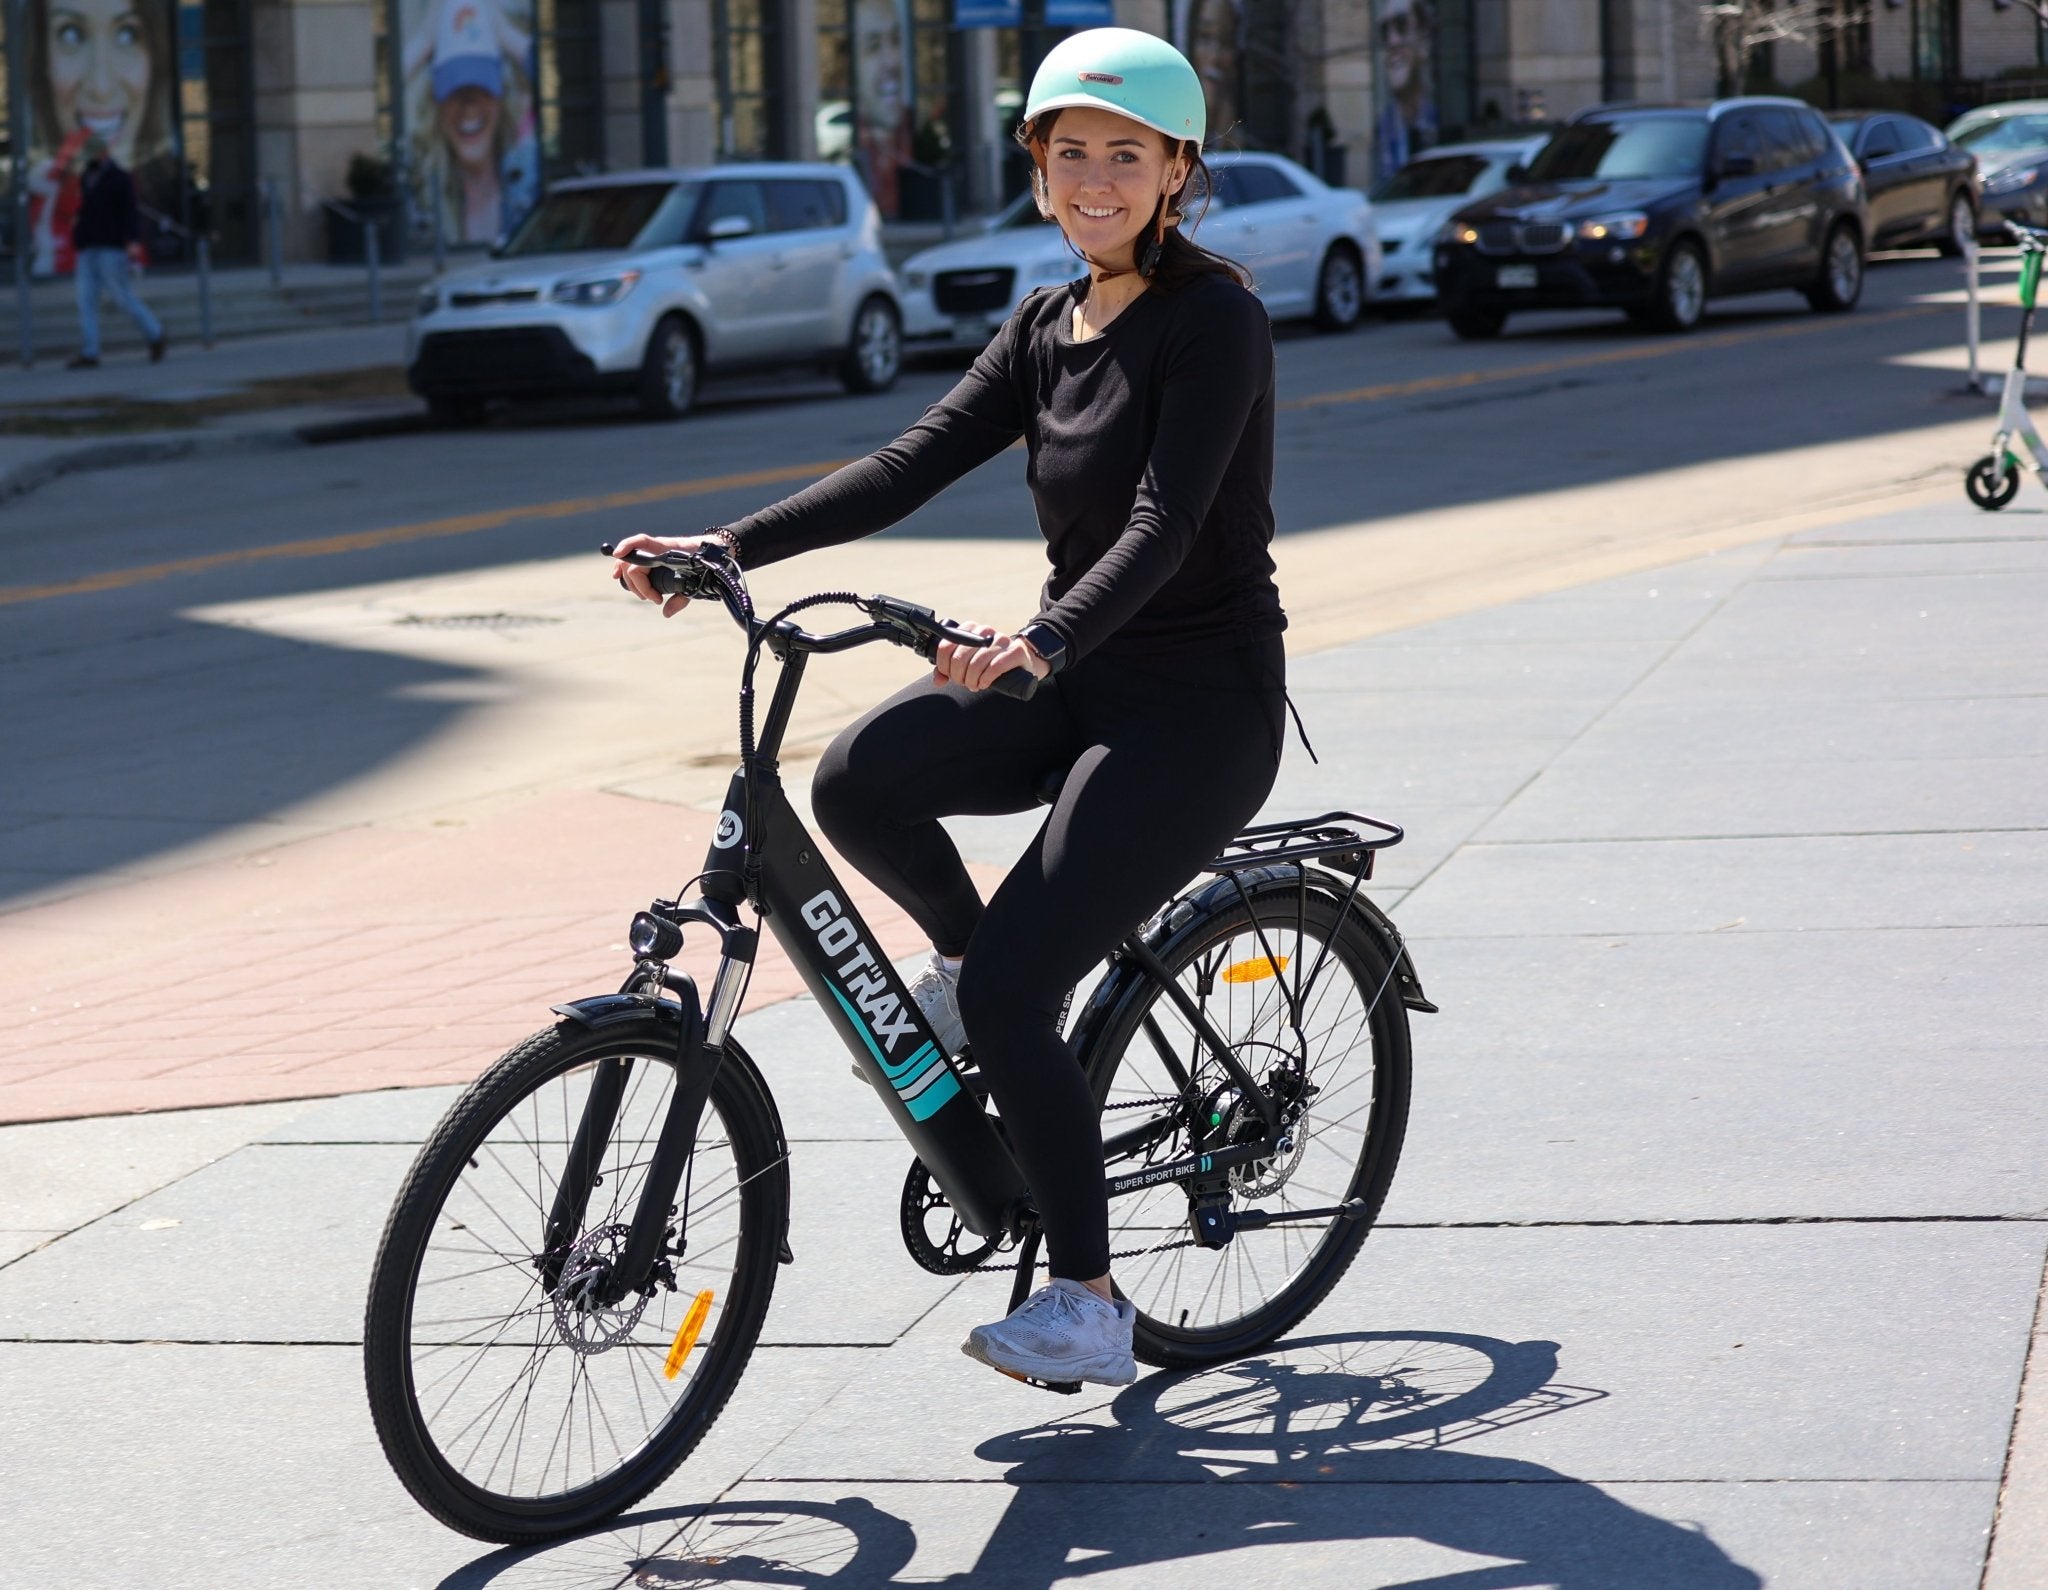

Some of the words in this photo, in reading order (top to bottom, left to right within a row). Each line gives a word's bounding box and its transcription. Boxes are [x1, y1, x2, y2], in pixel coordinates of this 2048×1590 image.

[800, 889, 919, 1055] GOTRAX
[1055, 1011, 1068, 1036] PER
[1114, 1176, 1144, 1191] SUPER
[1145, 1168, 1174, 1184] SPORT
[1176, 1163, 1196, 1177] BIKE
